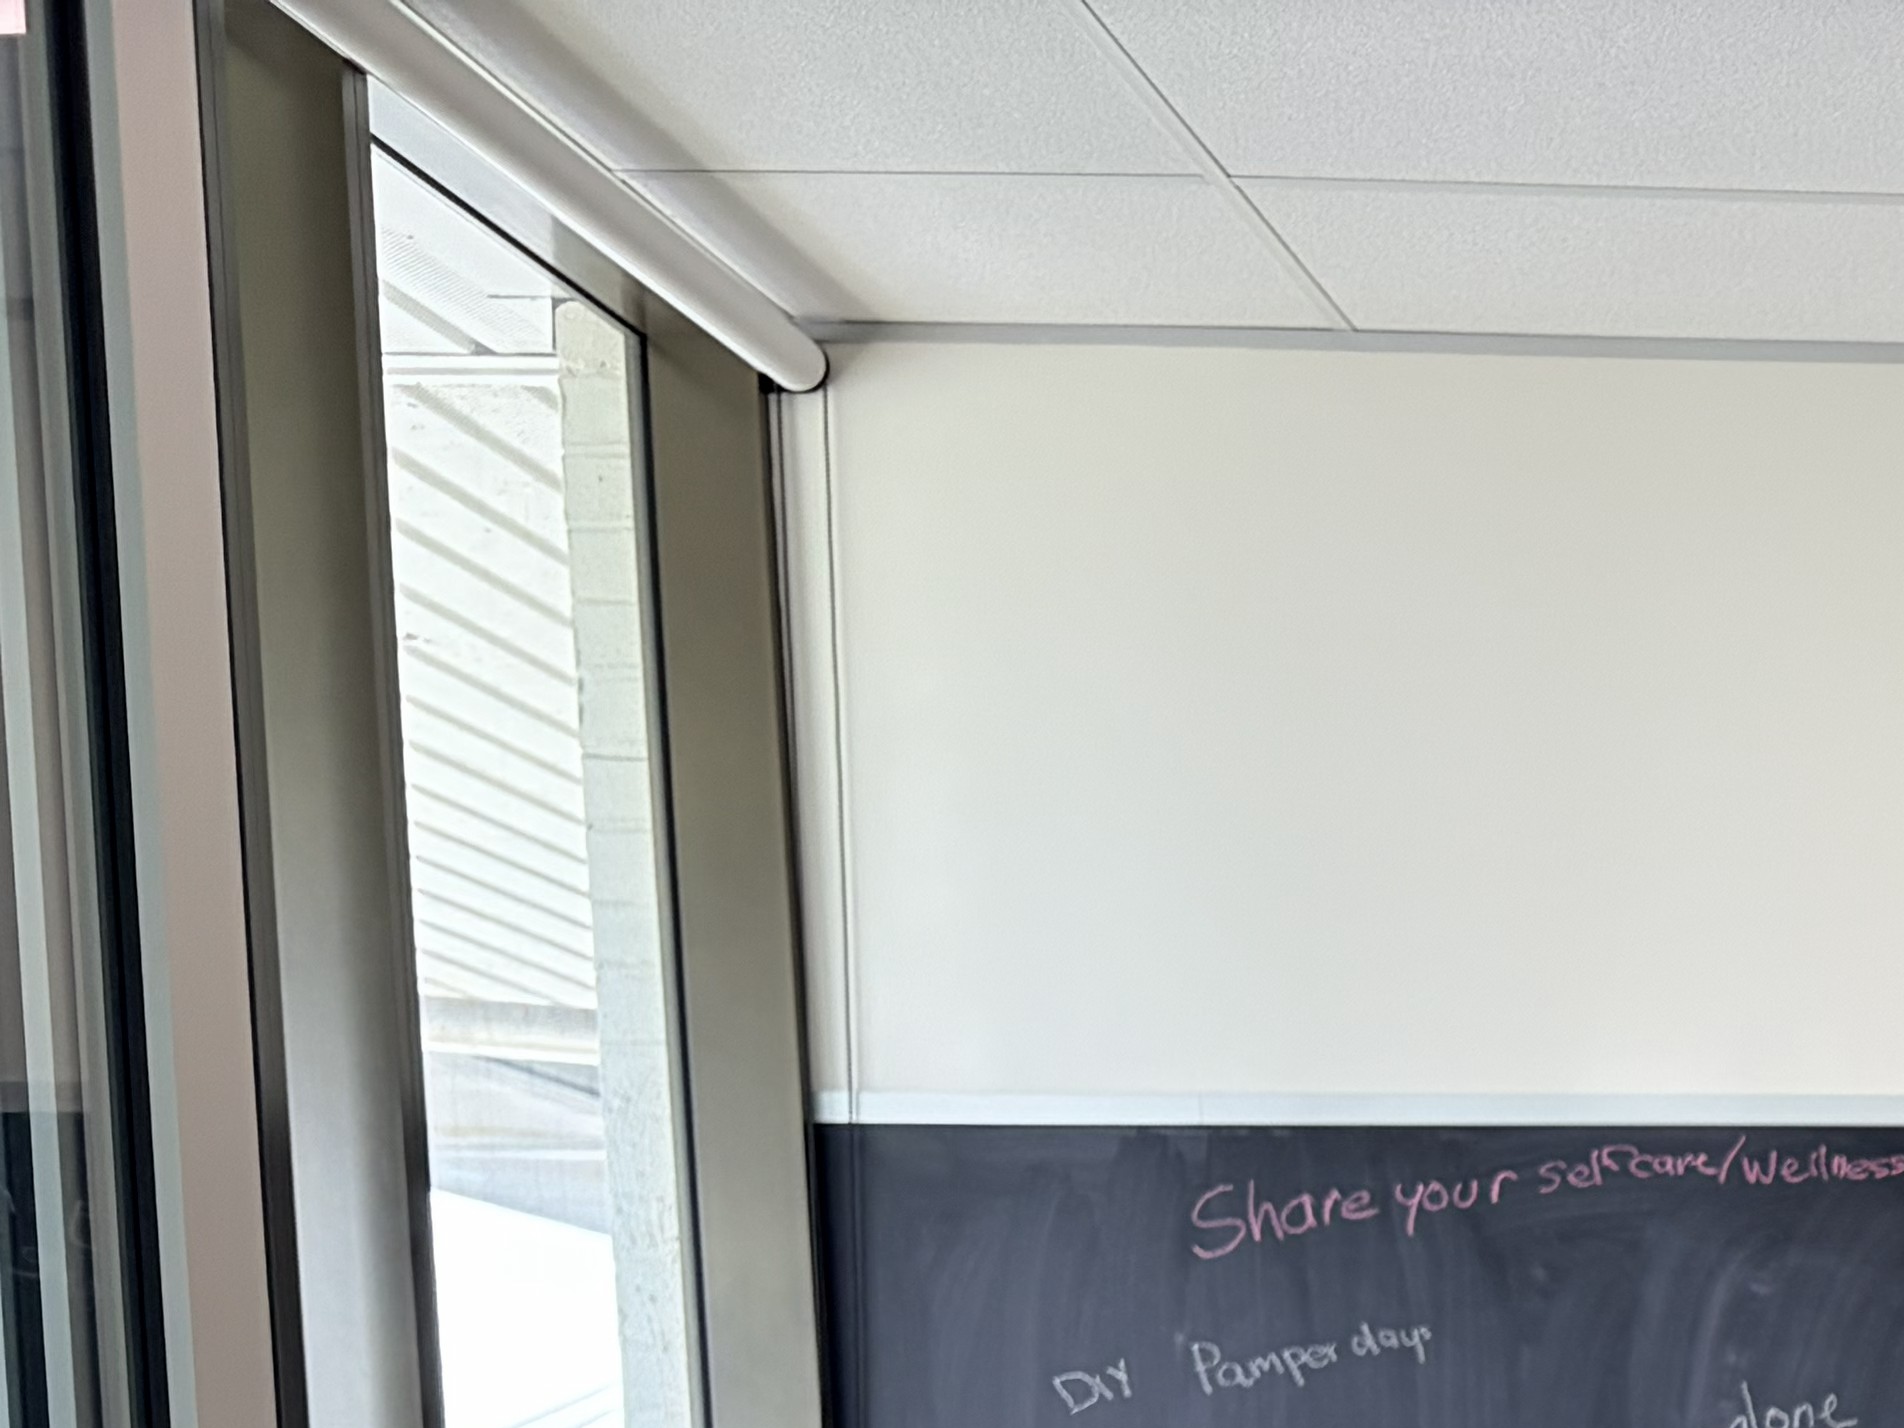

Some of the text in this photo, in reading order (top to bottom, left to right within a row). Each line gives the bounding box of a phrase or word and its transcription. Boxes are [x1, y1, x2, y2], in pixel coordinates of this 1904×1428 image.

[1190, 1179, 1380, 1260] Share
[1394, 1169, 1517, 1237] your
[1051, 1357, 1132, 1415] DIY
[1190, 1340, 1338, 1396] Pamper
